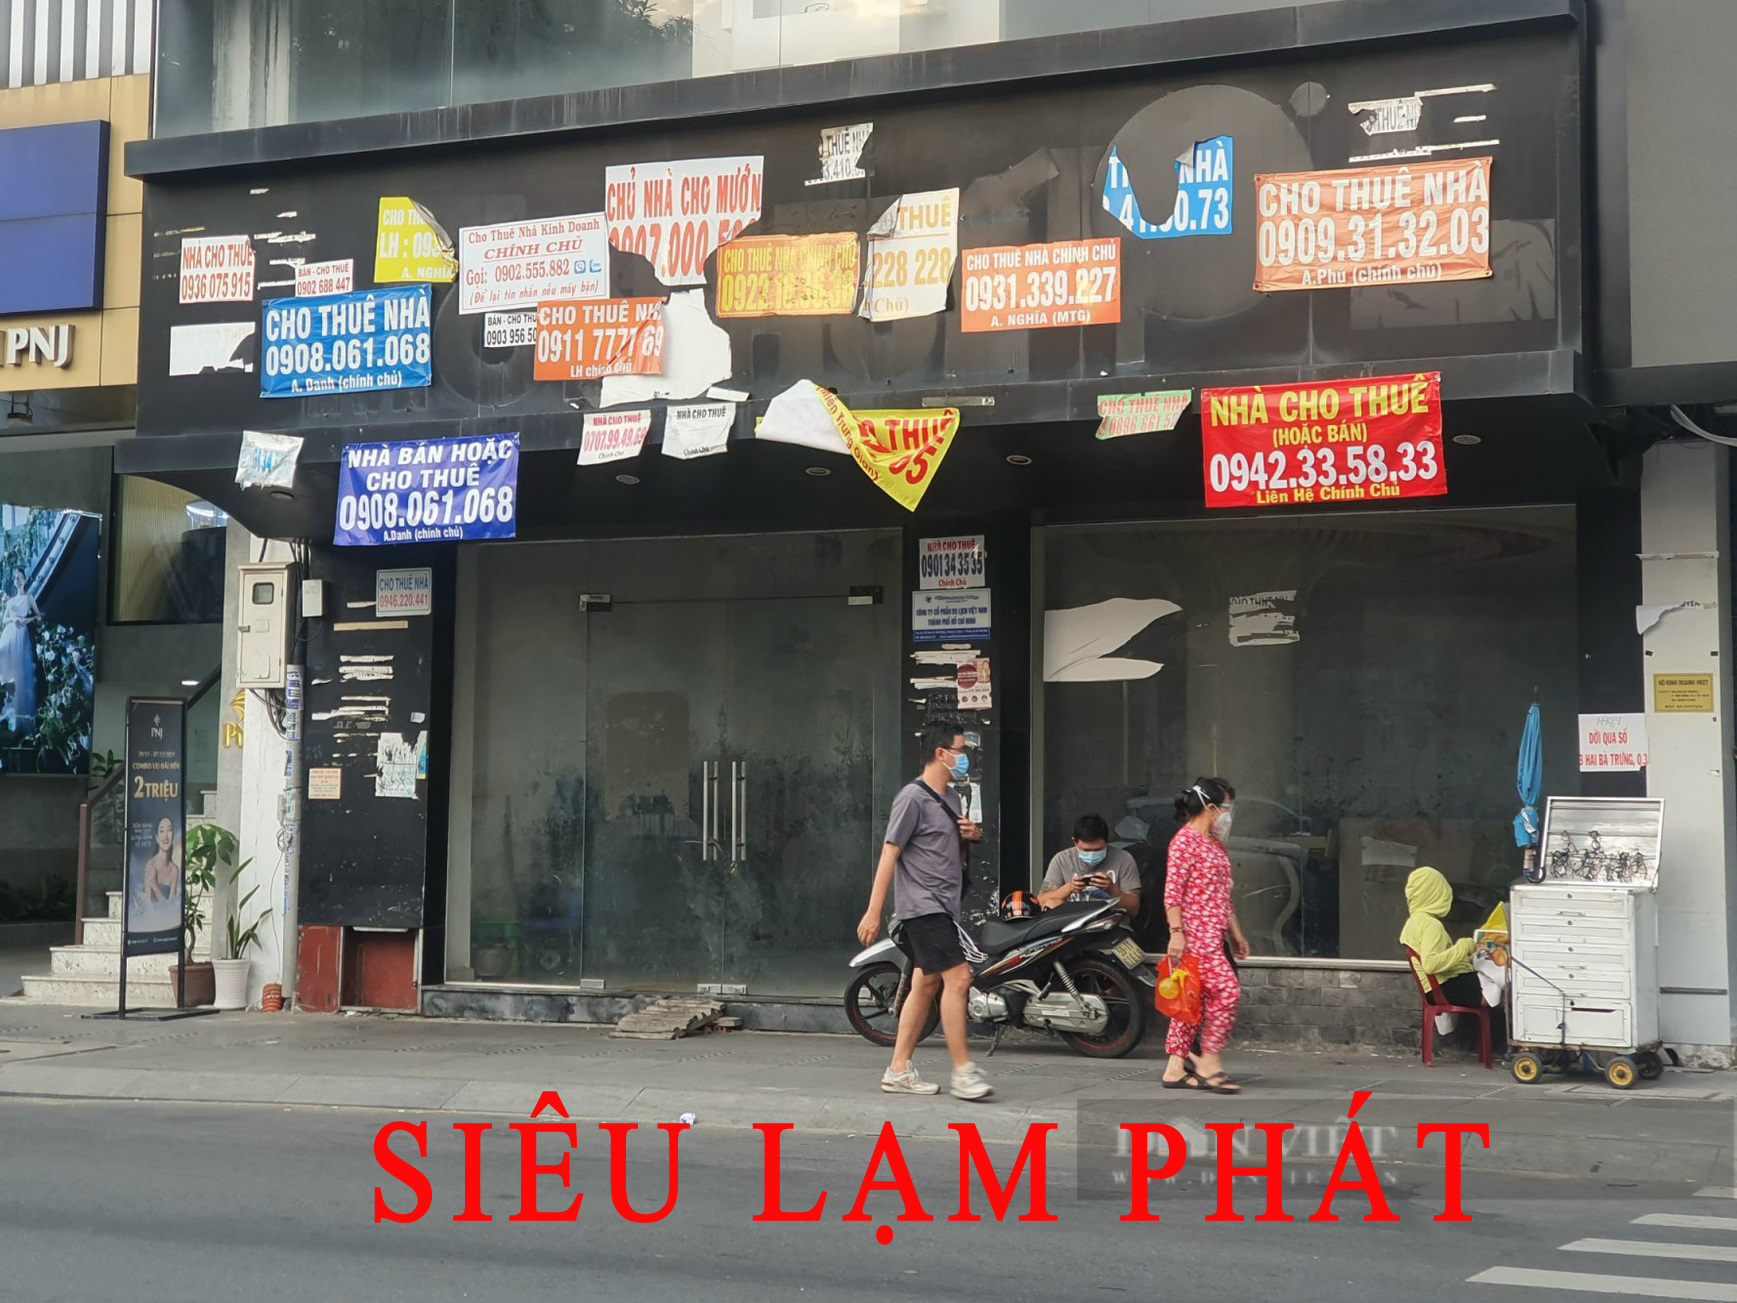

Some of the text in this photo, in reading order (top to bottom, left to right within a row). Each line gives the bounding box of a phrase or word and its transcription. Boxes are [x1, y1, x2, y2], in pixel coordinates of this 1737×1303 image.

[607, 166, 636, 222] CHỦ
[644, 168, 673, 218] NHÀ
[681, 176, 710, 216] CHO
[1259, 160, 1488, 217] CHO THUÊ NHÀ
[384, 209, 404, 226] CHO
[898, 197, 951, 230] THUÊ
[469, 218, 600, 244] Cho Thuê Nhà Kinh Doanh
[1258, 206, 1489, 267] 0909.31.32.03
[183, 239, 252, 269] NHÀ CHO THUÊ
[380, 232, 399, 259] LH
[484, 235, 583, 260] CHÍNH CHỦ
[724, 248, 744, 272] CHO
[748, 242, 772, 272] THUÊ
[967, 239, 1116, 271] CHO THUÊ NHÀ CHÍNH CHỦ
[316, 266, 330, 276] CHO
[332, 264, 349, 273] THUÊ
[402, 268, 412, 278] A.
[467, 258, 569, 289] Gọi: 0902.555.882
[915, 247, 951, 285] 228
[182, 272, 251, 300] 0936 075 915
[298, 277, 350, 296] 0902 688 447
[504, 287, 516, 301] tin
[966, 266, 1116, 312] 0931.339.227
[266, 289, 430, 341] CHO THUÊ NHÀ
[507, 315, 521, 324] CHO
[524, 314, 537, 323] THU
[538, 300, 629, 326] CHO THUÊ
[991, 310, 1091, 327] A. NGHĨA (MTG)
[7, 322, 73, 368] PNJ
[487, 328, 537, 345] 0903 956 50
[538, 329, 584, 362] 0911
[642, 325, 664, 357] 69
[266, 333, 430, 376] 0908.061.068
[292, 380, 303, 393] A.
[306, 377, 335, 392] Danh
[338, 374, 373, 392] (chính
[570, 366, 582, 378] LH
[676, 406, 727, 420] NHÀ CHO THUÊ
[1210, 374, 1429, 427] NHÀ CHO THUÊ
[593, 413, 642, 426] NHÀ CHO THUÊ
[836, 412, 854, 449] Trung
[1273, 420, 1367, 449] (HOẶC BÁN)
[348, 438, 513, 468] NHÀ BÁN HOẶC
[1210, 440, 1438, 492] 0942.33.58.33
[366, 463, 480, 492] CHO THUÊ
[1256, 480, 1400, 504] Liên Hệ Chính Chủ
[340, 486, 513, 531] 0908.061.068
[384, 530, 412, 542] A.Danh
[415, 528, 441, 542] (chính
[942, 541, 957, 550] CHO
[957, 538, 976, 549] THUÊ
[380, 578, 394, 591] CHO
[395, 574, 412, 590] THUÊ
[380, 594, 428, 608] 0946.220.441
[1603, 732, 1617, 745] QUA
[1585, 754, 1597, 765] HAI
